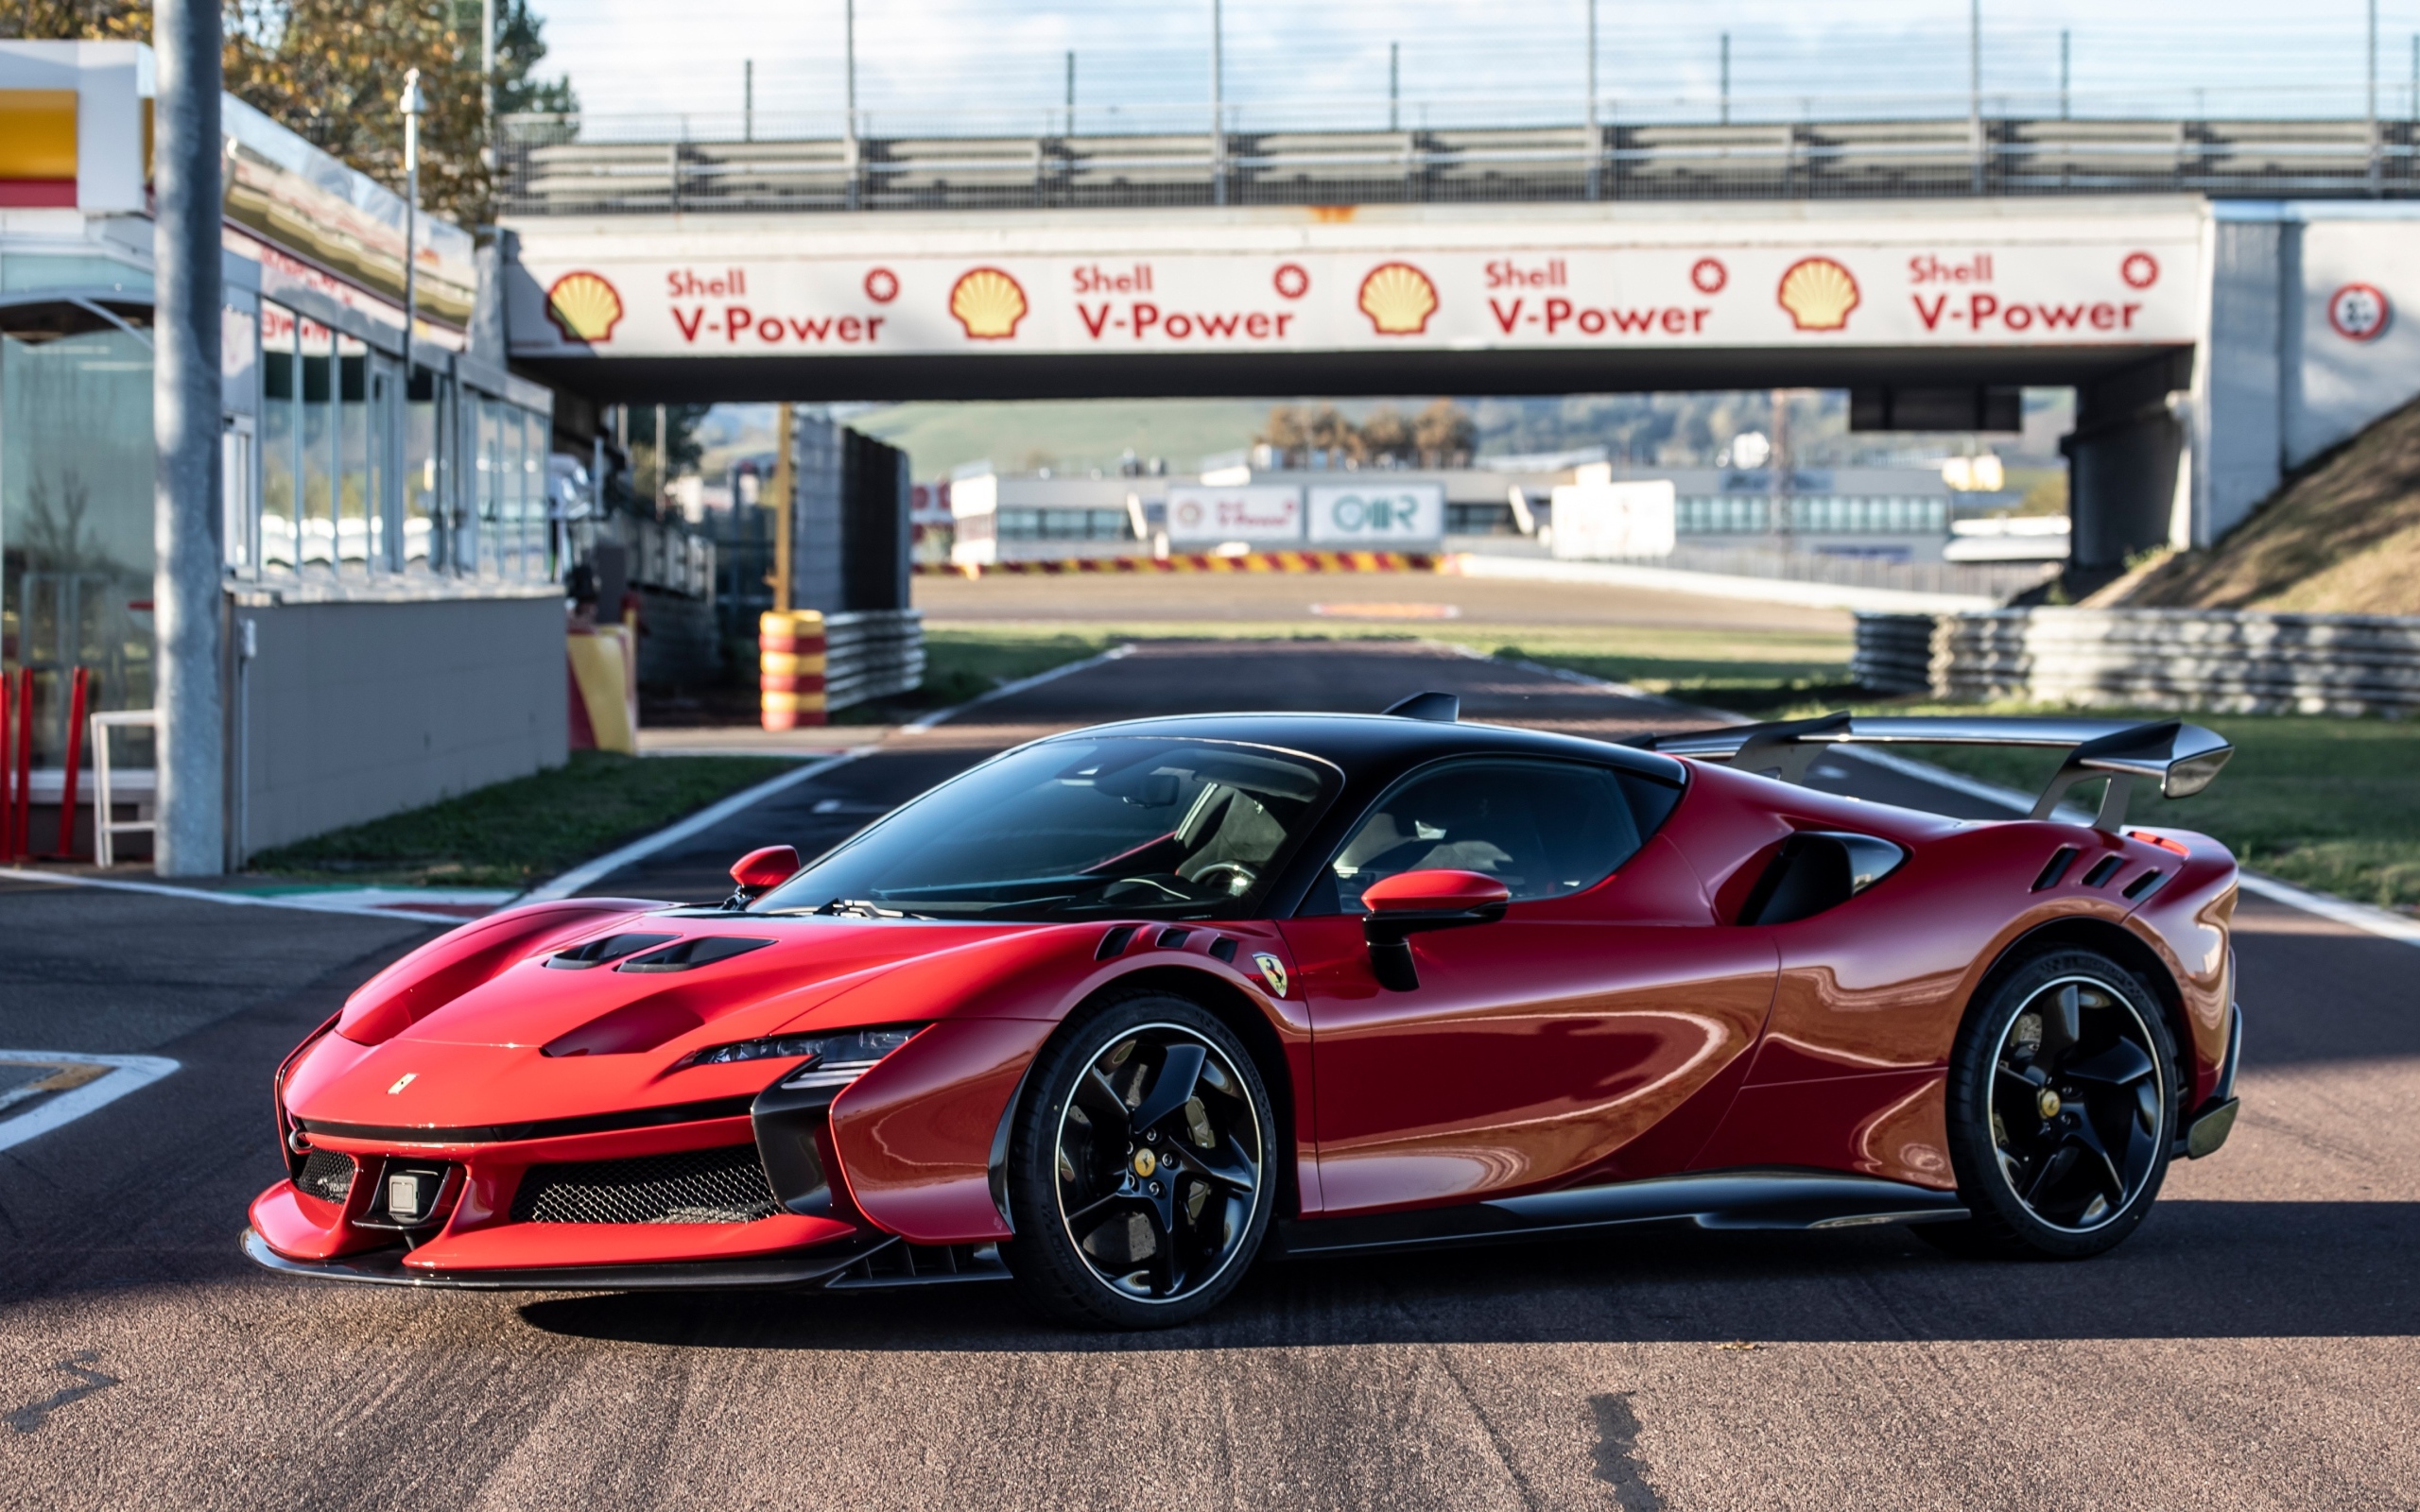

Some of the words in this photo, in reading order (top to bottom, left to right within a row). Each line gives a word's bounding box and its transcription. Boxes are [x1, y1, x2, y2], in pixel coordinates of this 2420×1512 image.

[667, 270, 746, 297] Shell
[1073, 266, 1153, 293] Shell
[1485, 261, 1567, 288] Shell
[1910, 256, 1992, 283] Shell
[671, 307, 889, 343] V-Power
[1078, 302, 1294, 340] V-Power
[1489, 298, 1713, 335] V-Power
[1912, 293, 2146, 332] V-Power
